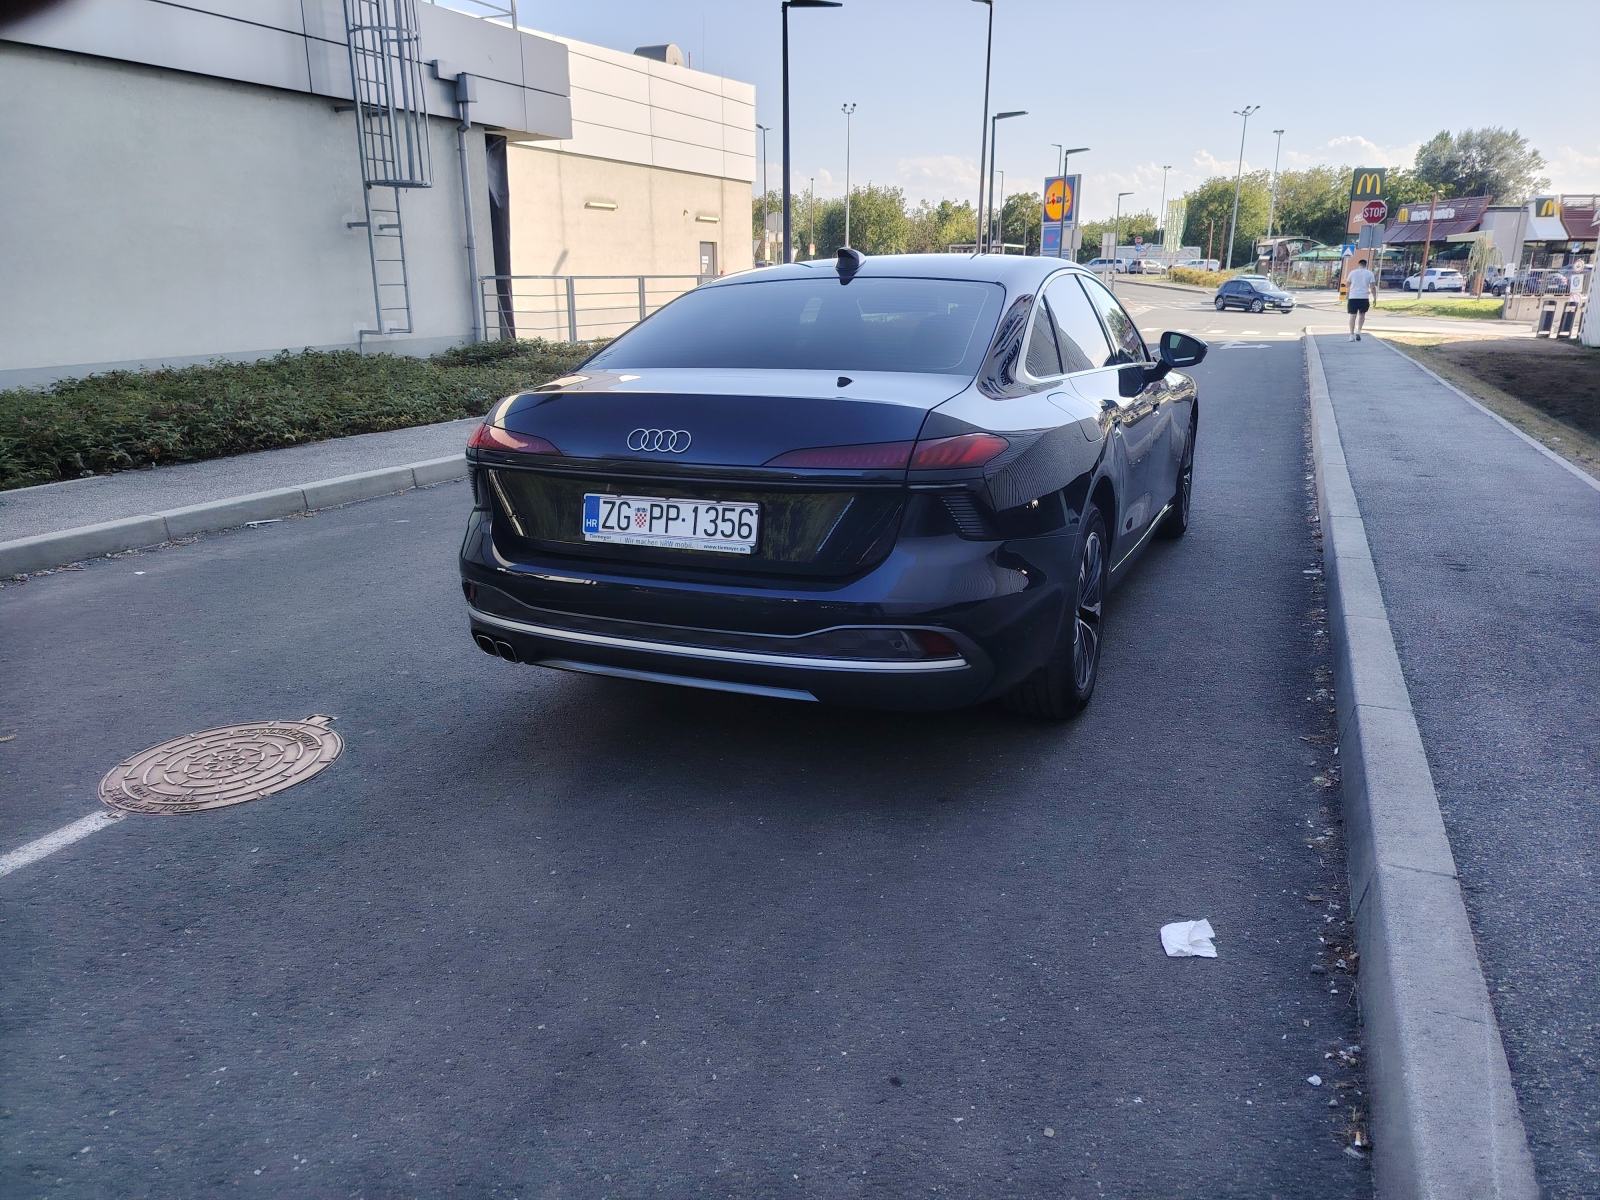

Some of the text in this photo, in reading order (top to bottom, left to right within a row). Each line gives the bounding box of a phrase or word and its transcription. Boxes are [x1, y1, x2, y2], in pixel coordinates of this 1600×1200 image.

[1363, 207, 1385, 218] STOP
[1410, 207, 1456, 222] McDoald's
[602, 500, 632, 531] ZG
[586, 519, 598, 528] HR
